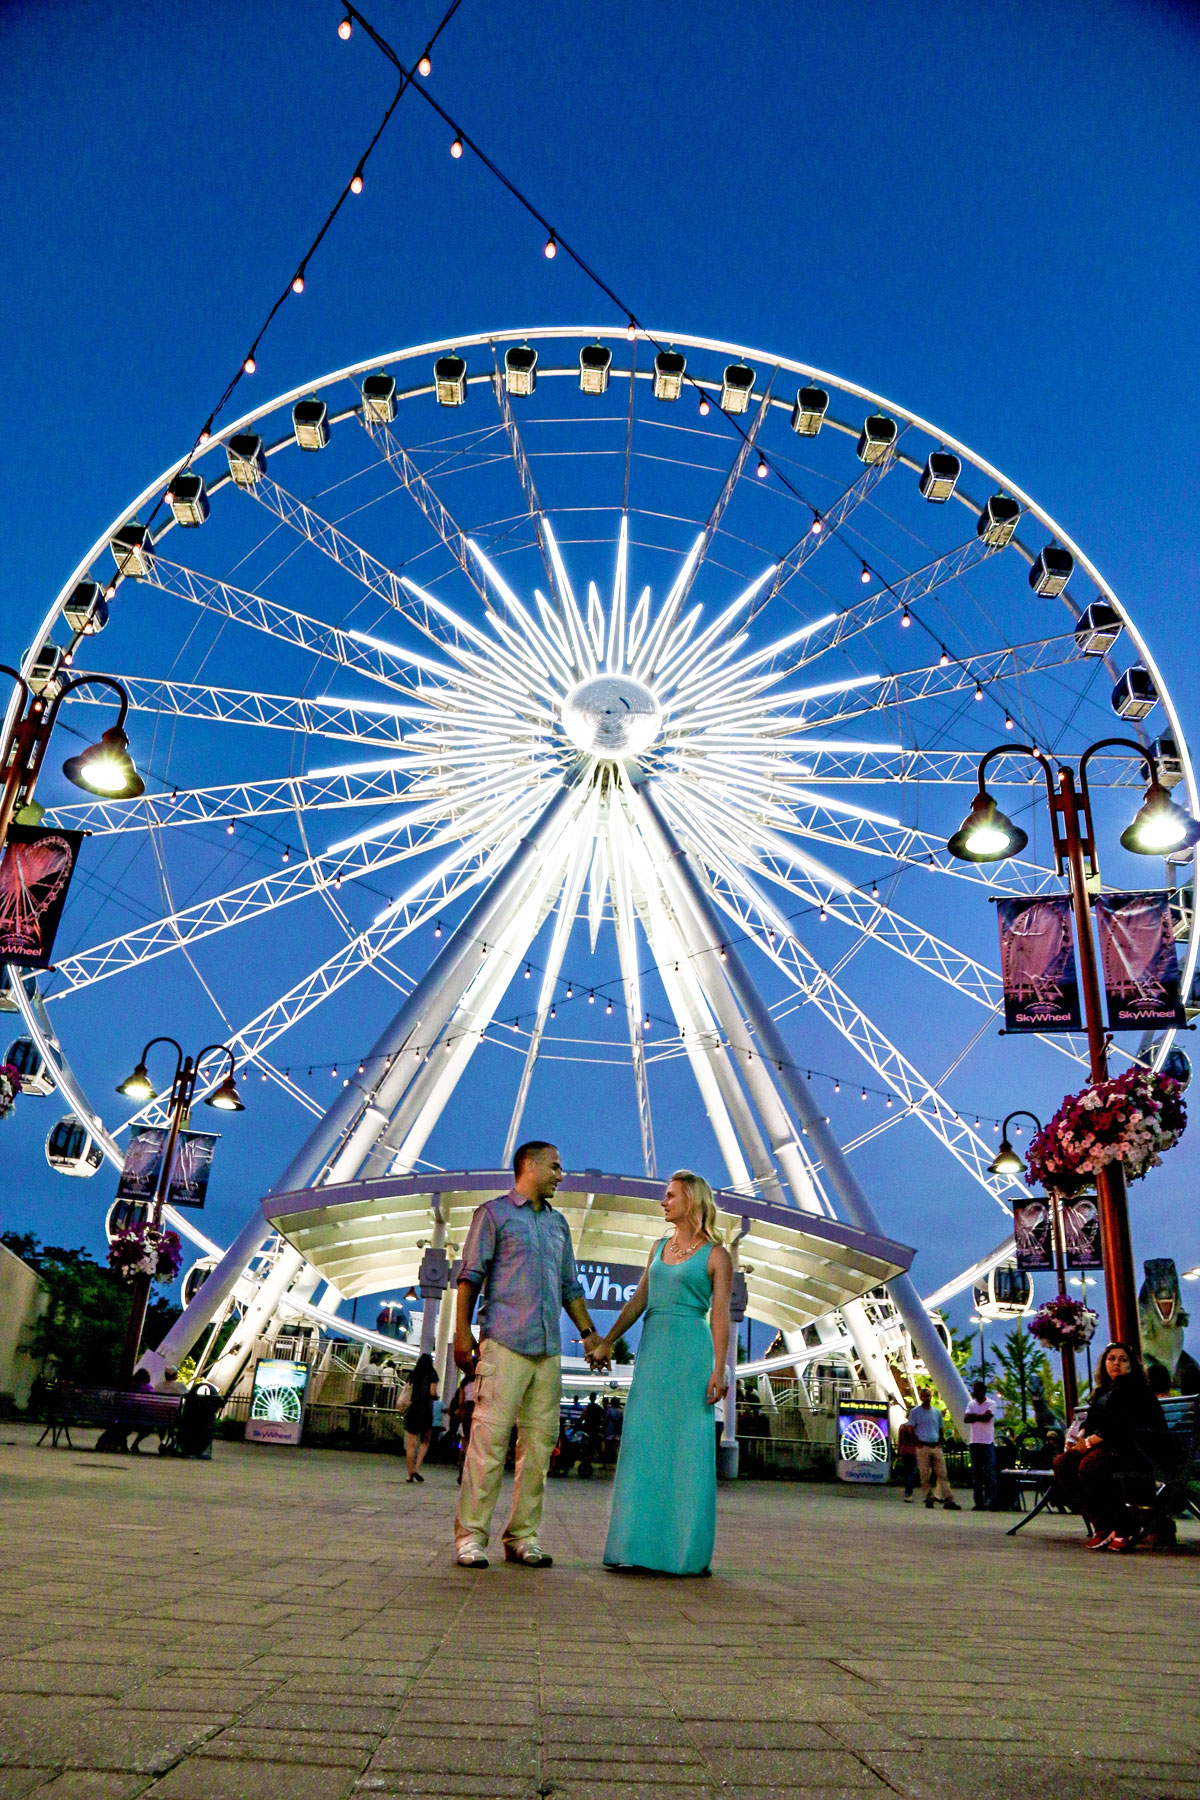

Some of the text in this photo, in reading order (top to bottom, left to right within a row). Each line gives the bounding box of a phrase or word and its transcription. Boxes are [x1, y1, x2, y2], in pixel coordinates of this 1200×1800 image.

[0, 945, 42, 956] yWheel
[1015, 1013, 1071, 1024] SkyWheel
[1118, 1009, 1176, 1020] SkyWheel
